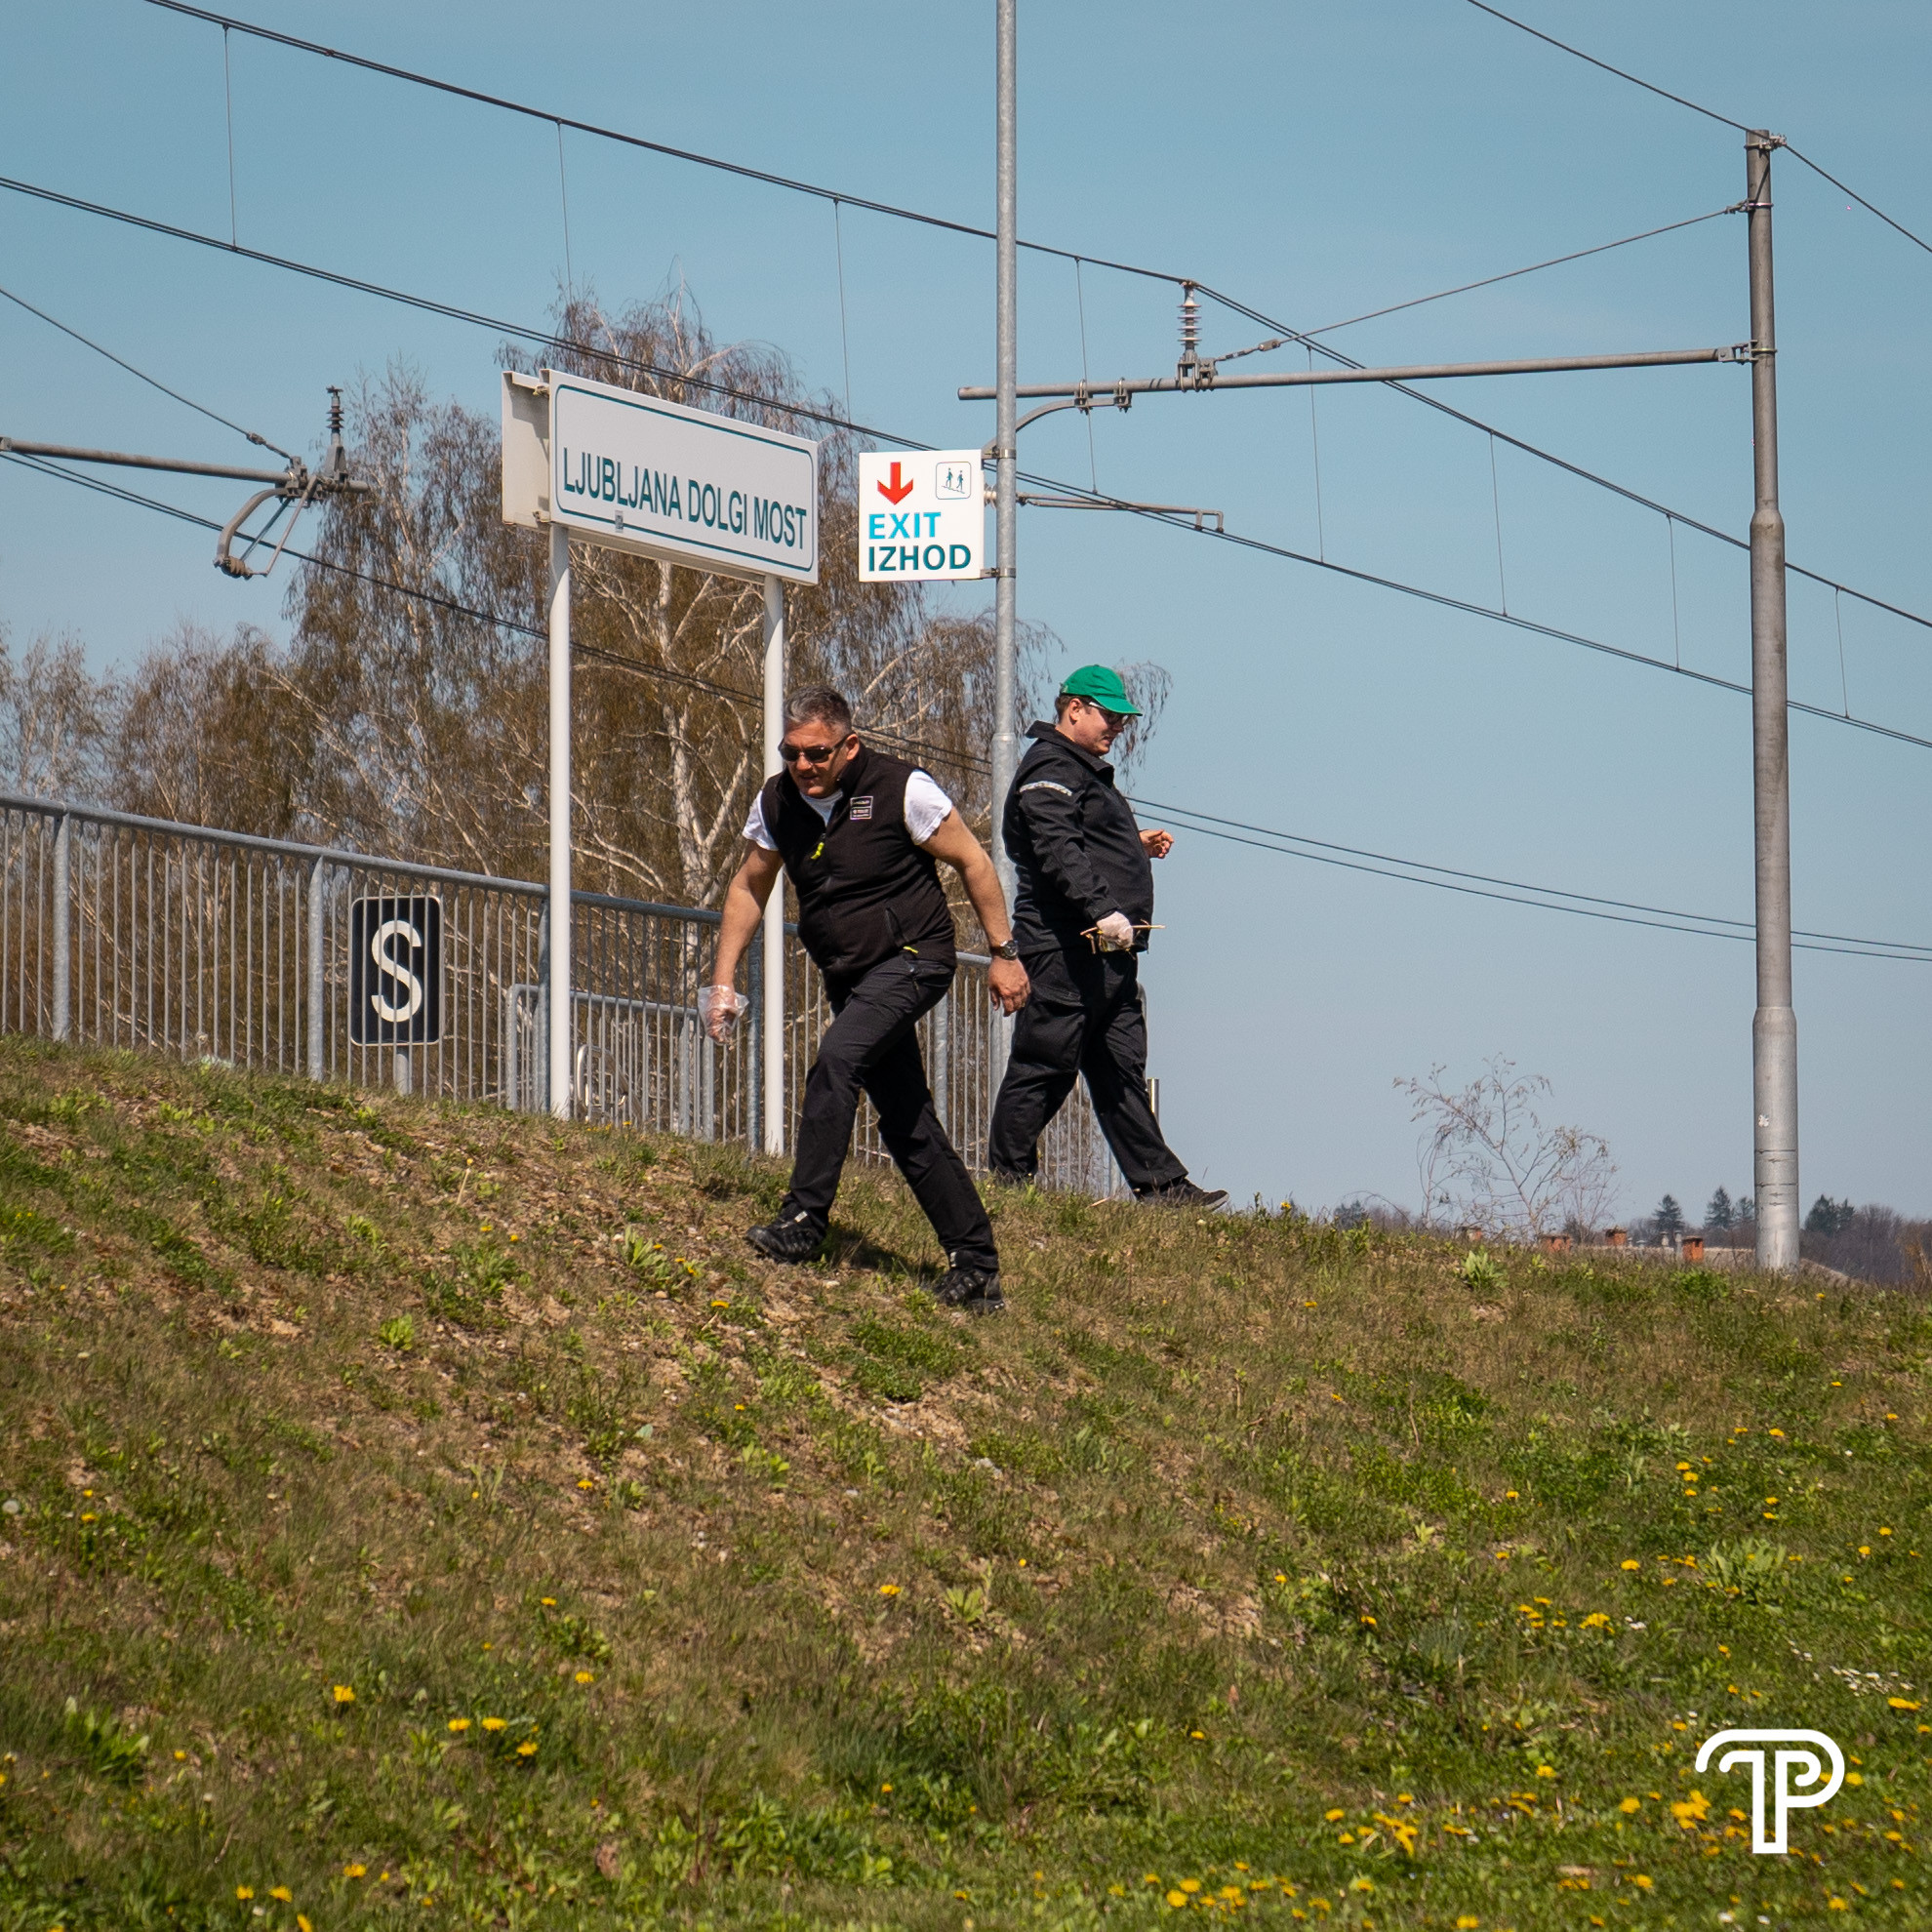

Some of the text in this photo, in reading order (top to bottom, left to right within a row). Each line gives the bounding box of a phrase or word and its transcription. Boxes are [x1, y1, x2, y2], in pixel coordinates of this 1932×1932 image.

[563, 447, 807, 549] LJUBLJANA DOLGI MOST
[868, 511, 942, 540] EXIT
[868, 543, 972, 572] IZHOD
[371, 919, 423, 1023] S
